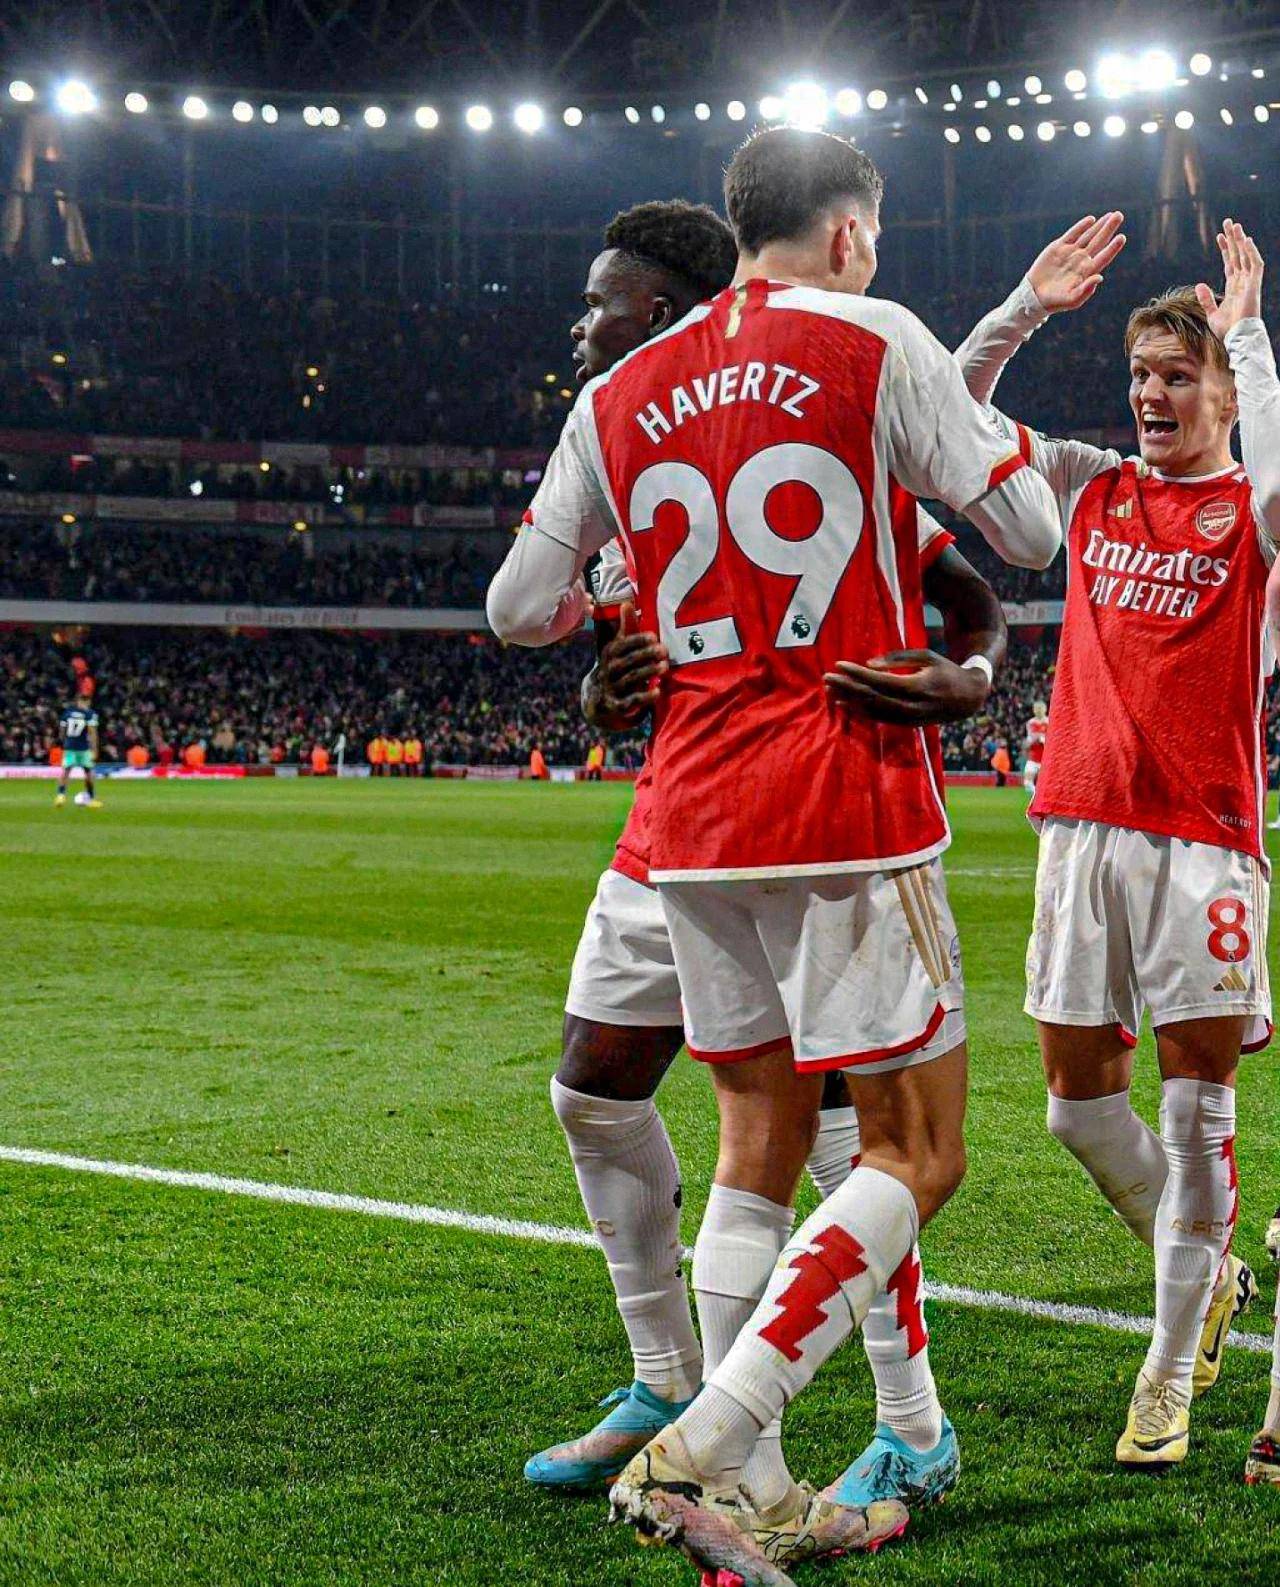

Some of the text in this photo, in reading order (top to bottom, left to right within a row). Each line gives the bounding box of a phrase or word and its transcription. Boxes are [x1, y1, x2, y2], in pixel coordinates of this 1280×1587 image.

[635, 361, 820, 445] HAVERTZ
[629, 442, 865, 666] 29
[1082, 529, 1230, 587] Emirates
[1088, 575, 1199, 618] FLY BETTER
[1207, 898, 1250, 962] 8
